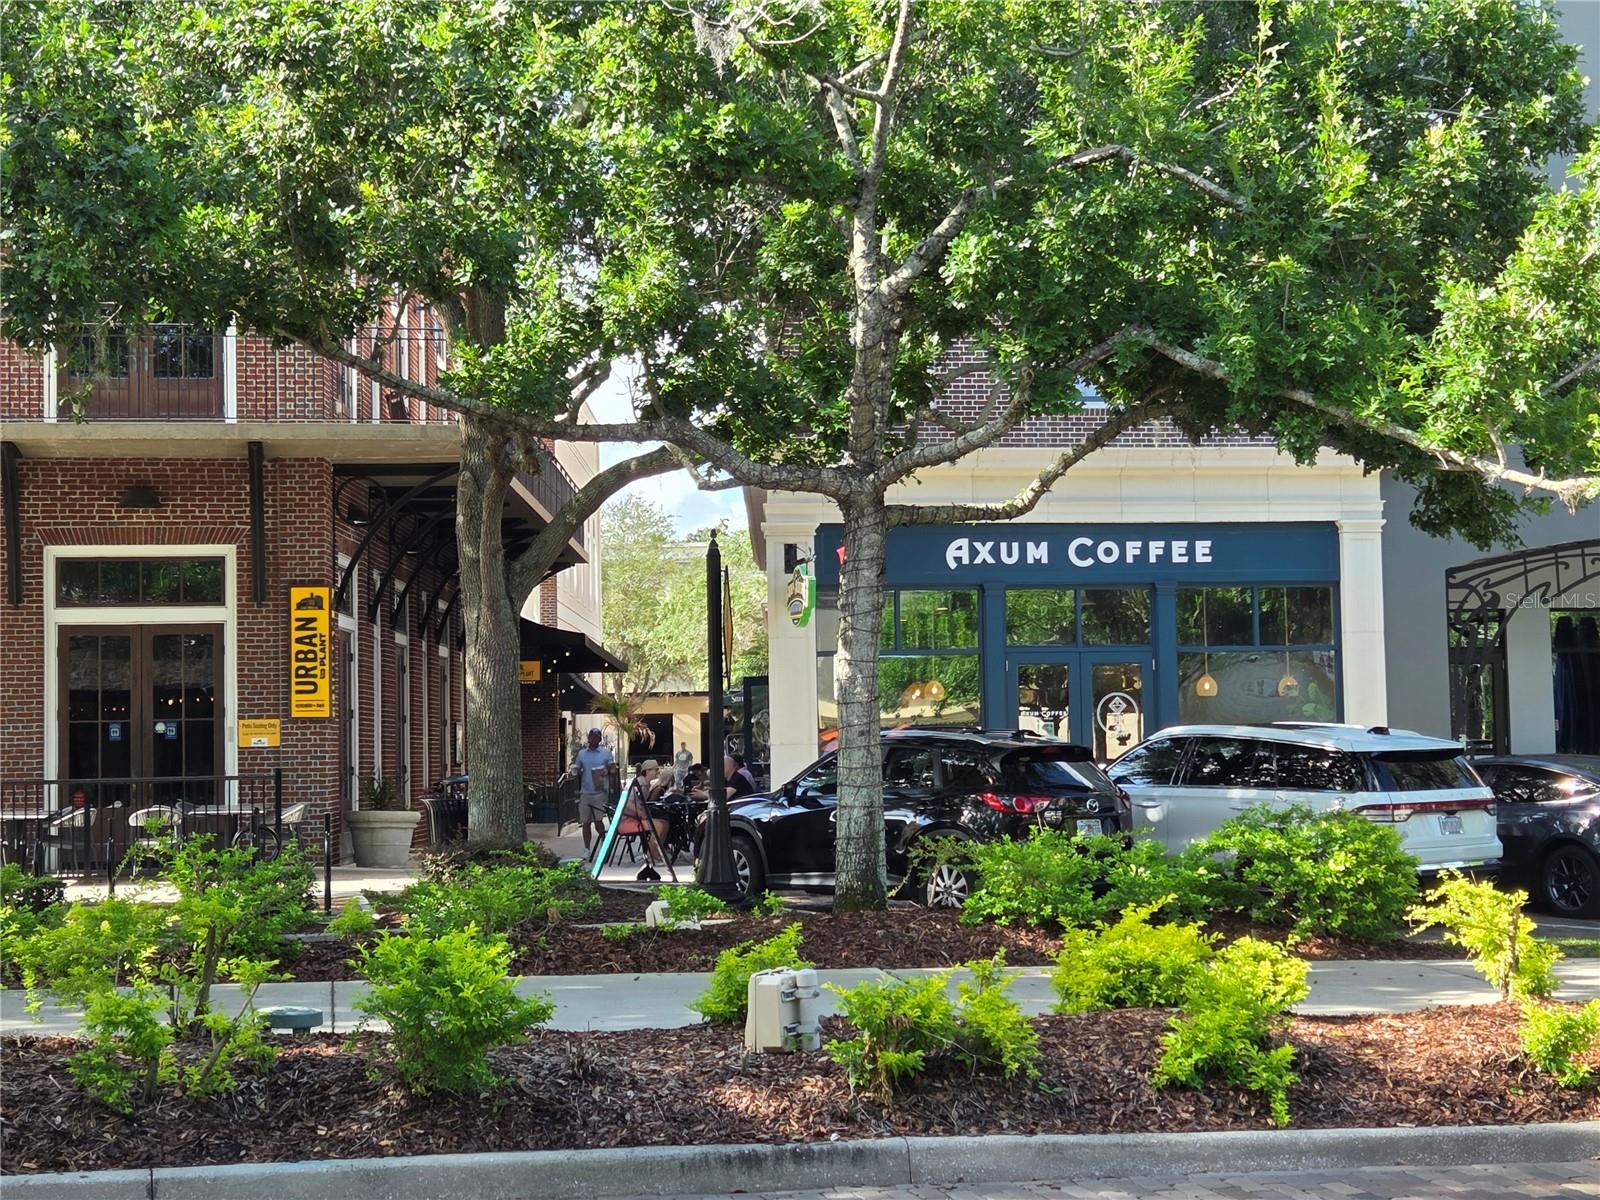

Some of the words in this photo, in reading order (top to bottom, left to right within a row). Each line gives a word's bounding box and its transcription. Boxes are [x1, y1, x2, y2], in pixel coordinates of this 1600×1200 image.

[946, 538, 1049, 570] AXUM
[1068, 537, 1213, 567] COFFEE
[295, 617, 318, 695] URBAN
[319, 634, 327, 666] PLANT
